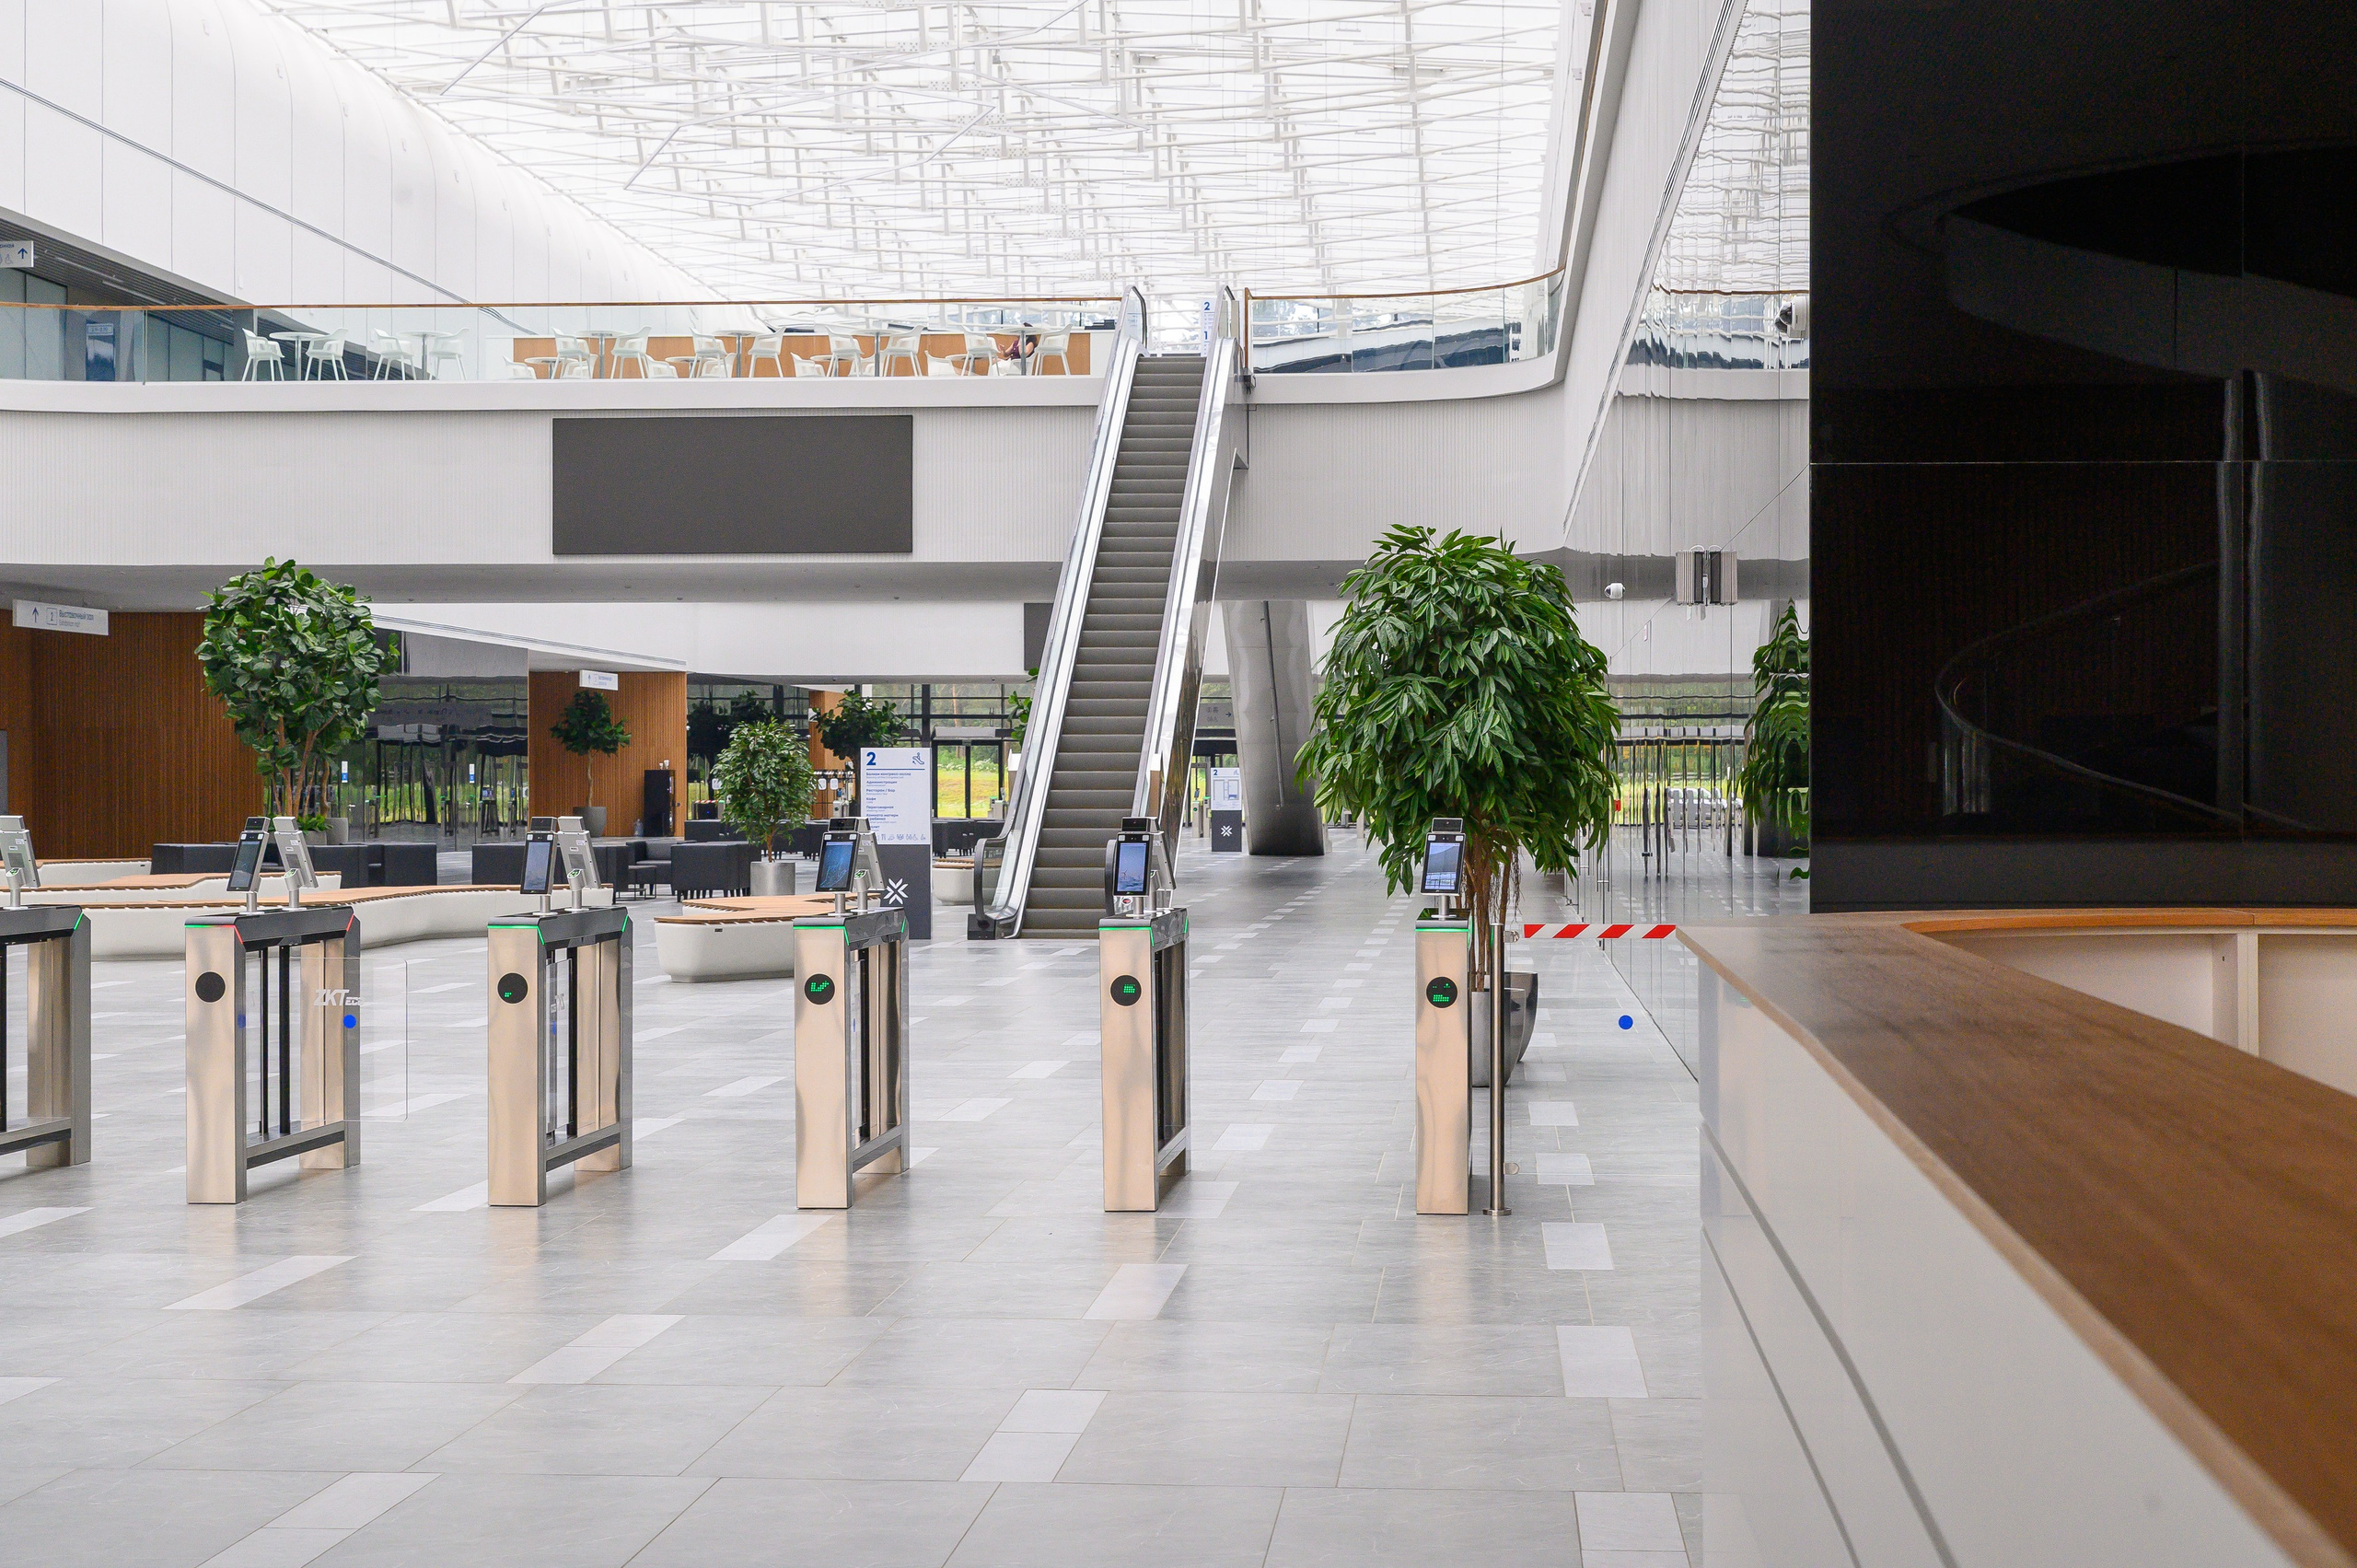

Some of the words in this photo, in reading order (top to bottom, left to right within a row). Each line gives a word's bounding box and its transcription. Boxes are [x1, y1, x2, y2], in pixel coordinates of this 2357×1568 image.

[1204, 301, 1210, 311] 2
[1204, 331, 1208, 340] 1
[866, 751, 877, 766] 2
